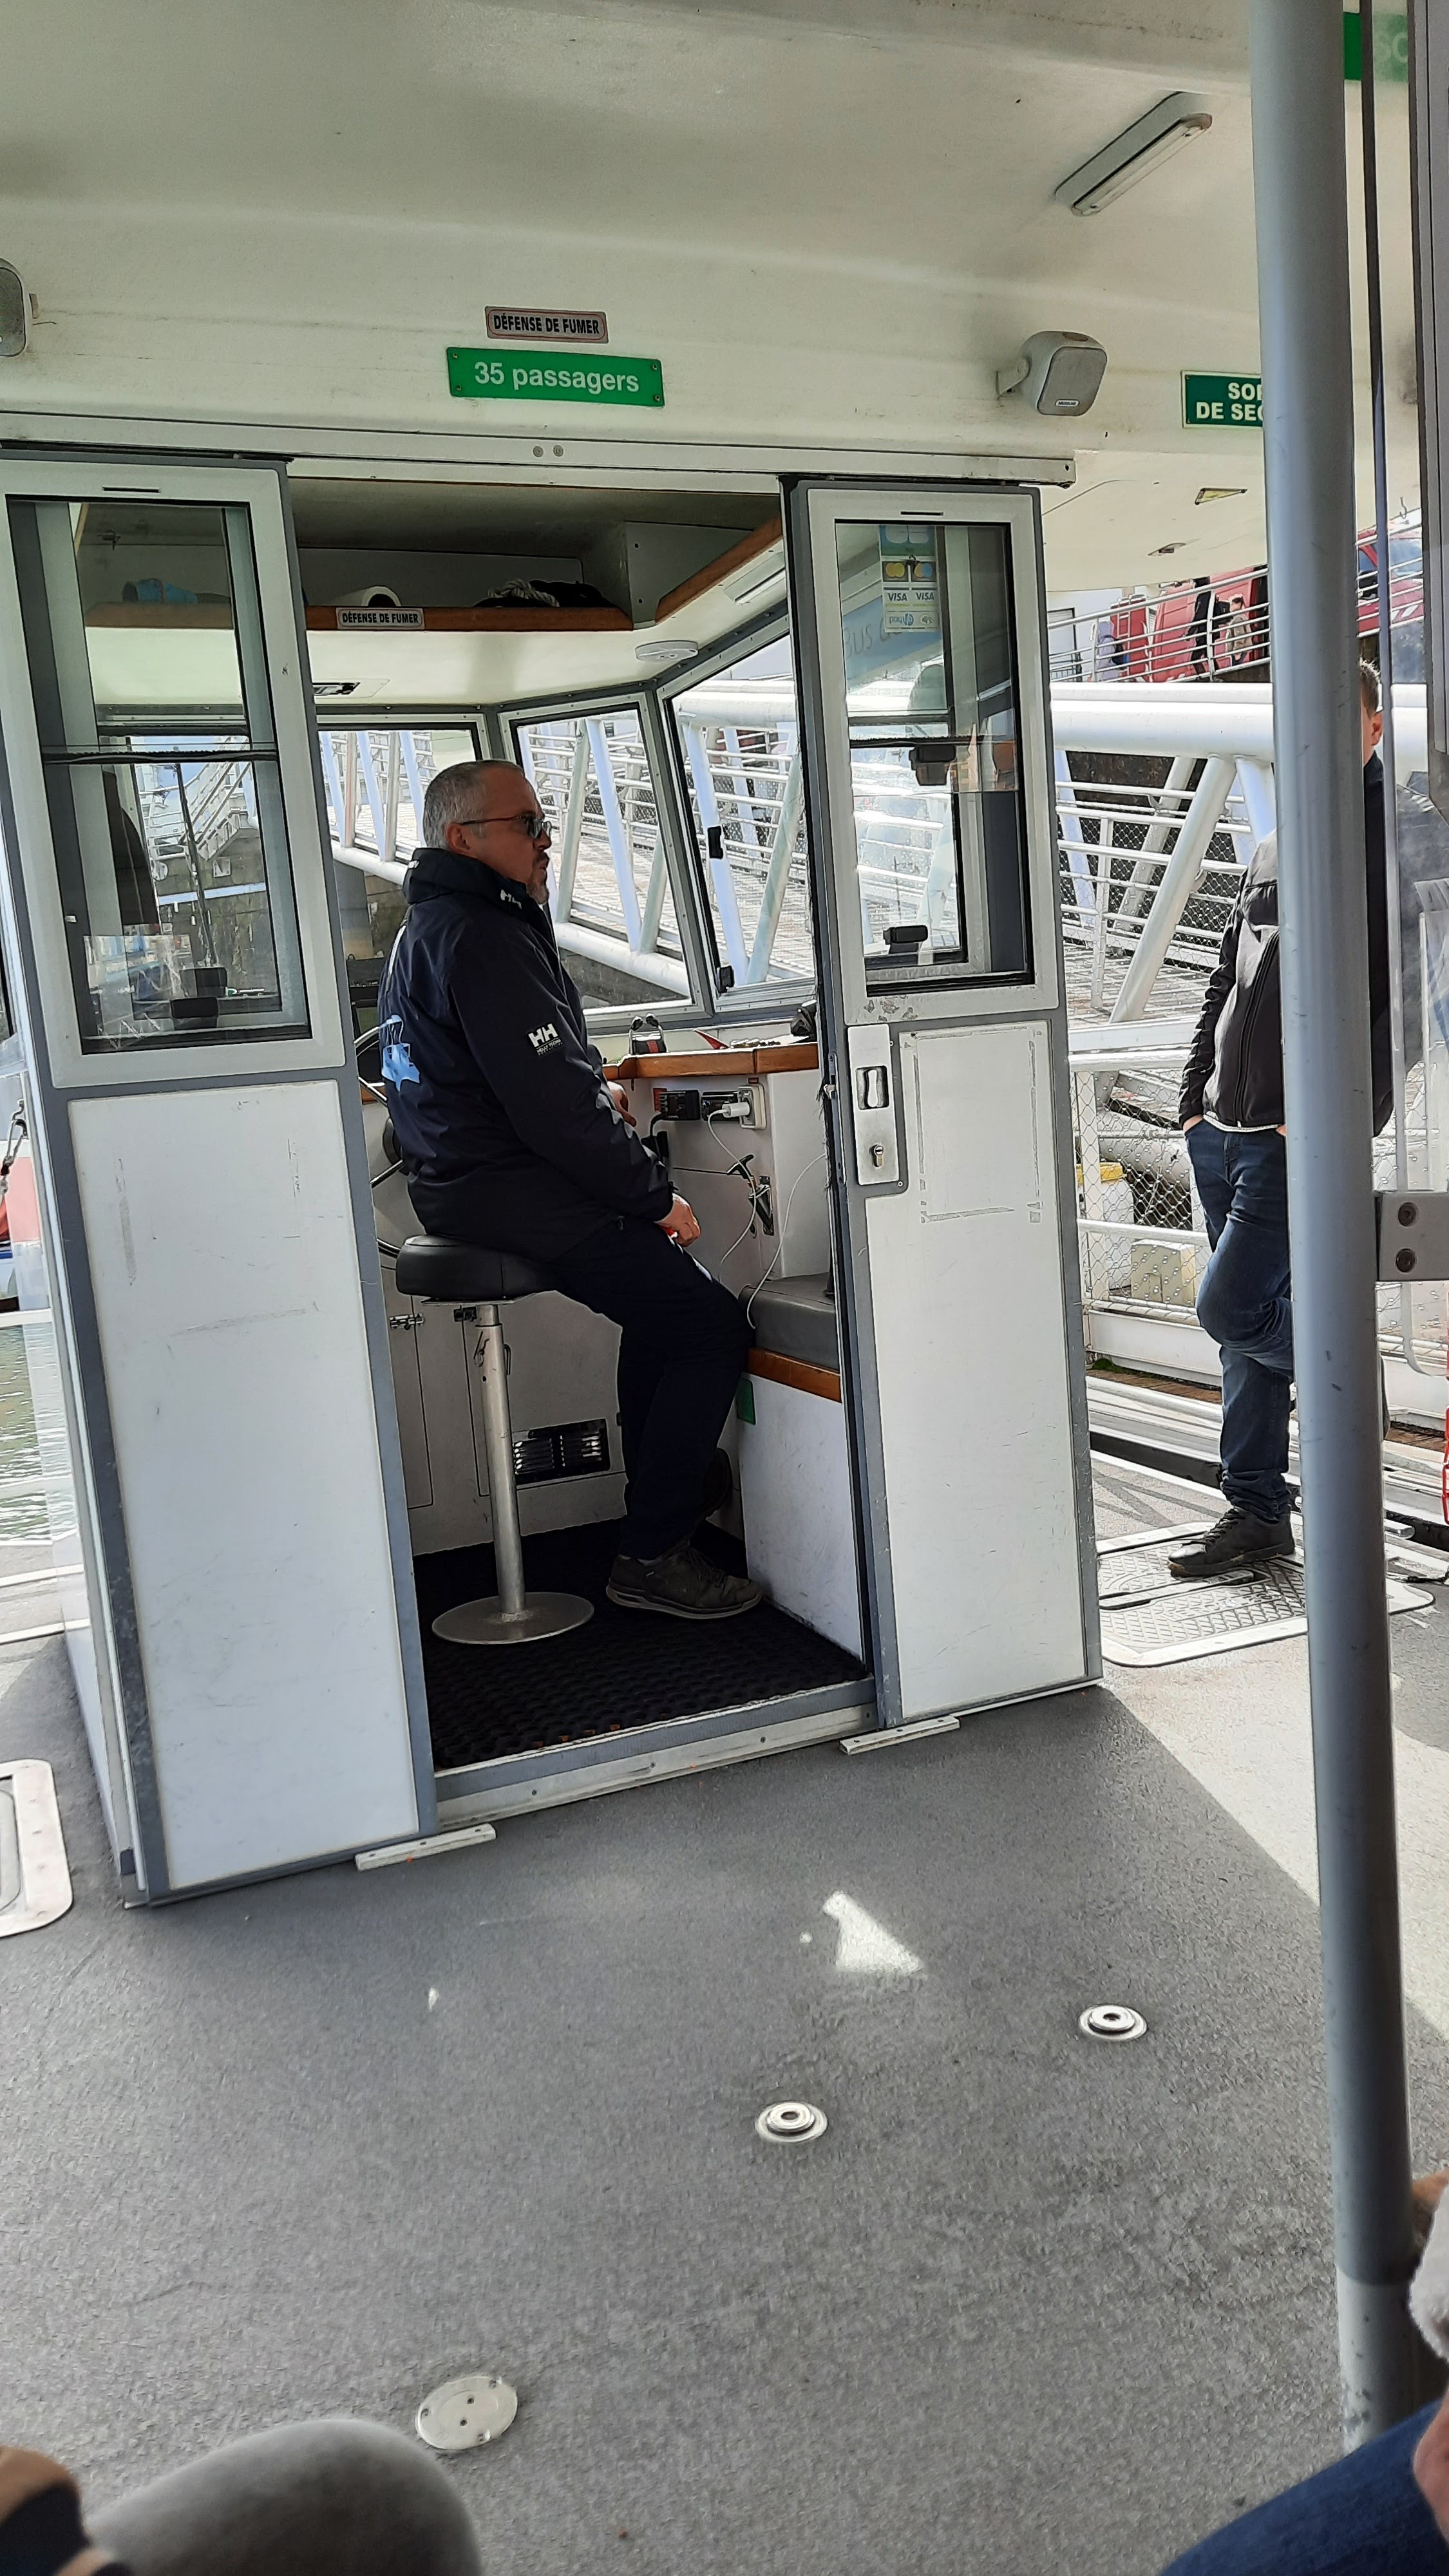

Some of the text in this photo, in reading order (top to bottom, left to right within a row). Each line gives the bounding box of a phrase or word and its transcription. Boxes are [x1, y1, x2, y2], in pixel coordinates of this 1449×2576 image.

[493, 312, 600, 334] DÉFENSE DE FUMER
[475, 361, 639, 395] 35 passagers
[1196, 401, 1224, 419] DE
[887, 592, 934, 601] VISA VISA
[342, 611, 419, 623] DÉFENSE DE FUMER
[528, 1023, 558, 1048] HH
